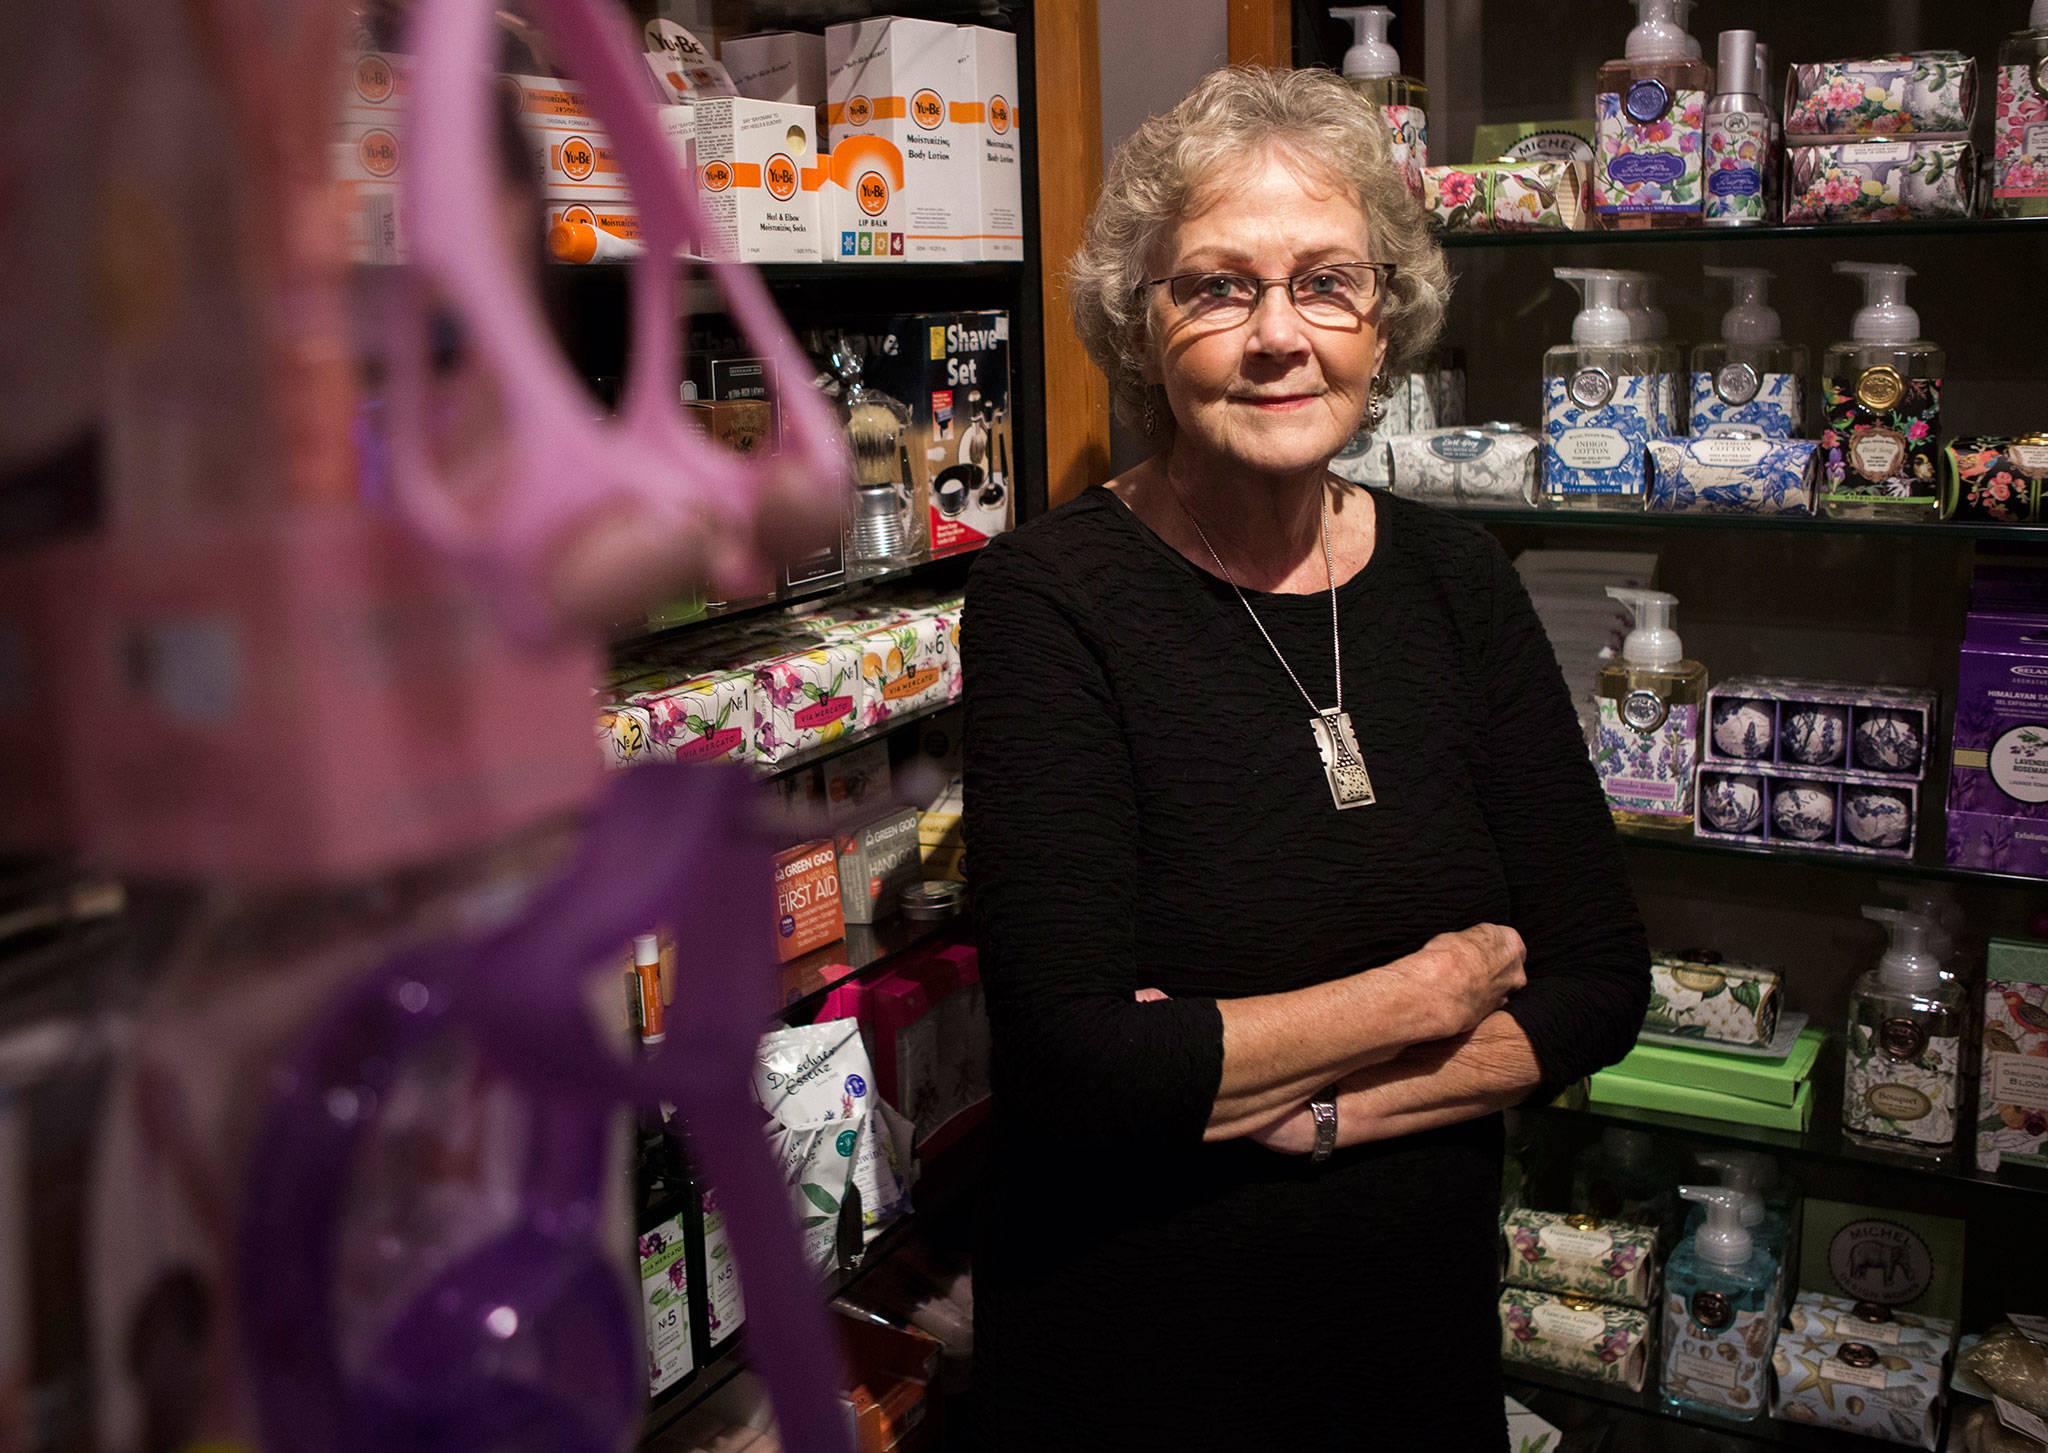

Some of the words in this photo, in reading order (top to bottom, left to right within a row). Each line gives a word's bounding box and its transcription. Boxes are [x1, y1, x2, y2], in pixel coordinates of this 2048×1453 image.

[1518, 139, 1577, 155] MICHEL
[946, 323, 998, 353] Shave
[947, 357, 977, 386] Set
[890, 686, 901, 695] VIA
[903, 674, 933, 690] MERCATO
[1987, 690, 2037, 700] HIMALAYAN
[801, 713, 813, 722] VIA
[815, 703, 847, 719] MERCATO
[684, 749, 697, 758] VIA
[702, 735, 735, 752] MERCATO
[874, 824, 898, 842] GREEN
[899, 816, 917, 833] GOO
[785, 857, 813, 878] GREEN
[813, 850, 834, 867] GOO
[869, 853, 897, 878] HAND
[778, 884, 812, 915] FIRST
[815, 874, 838, 901] AID
